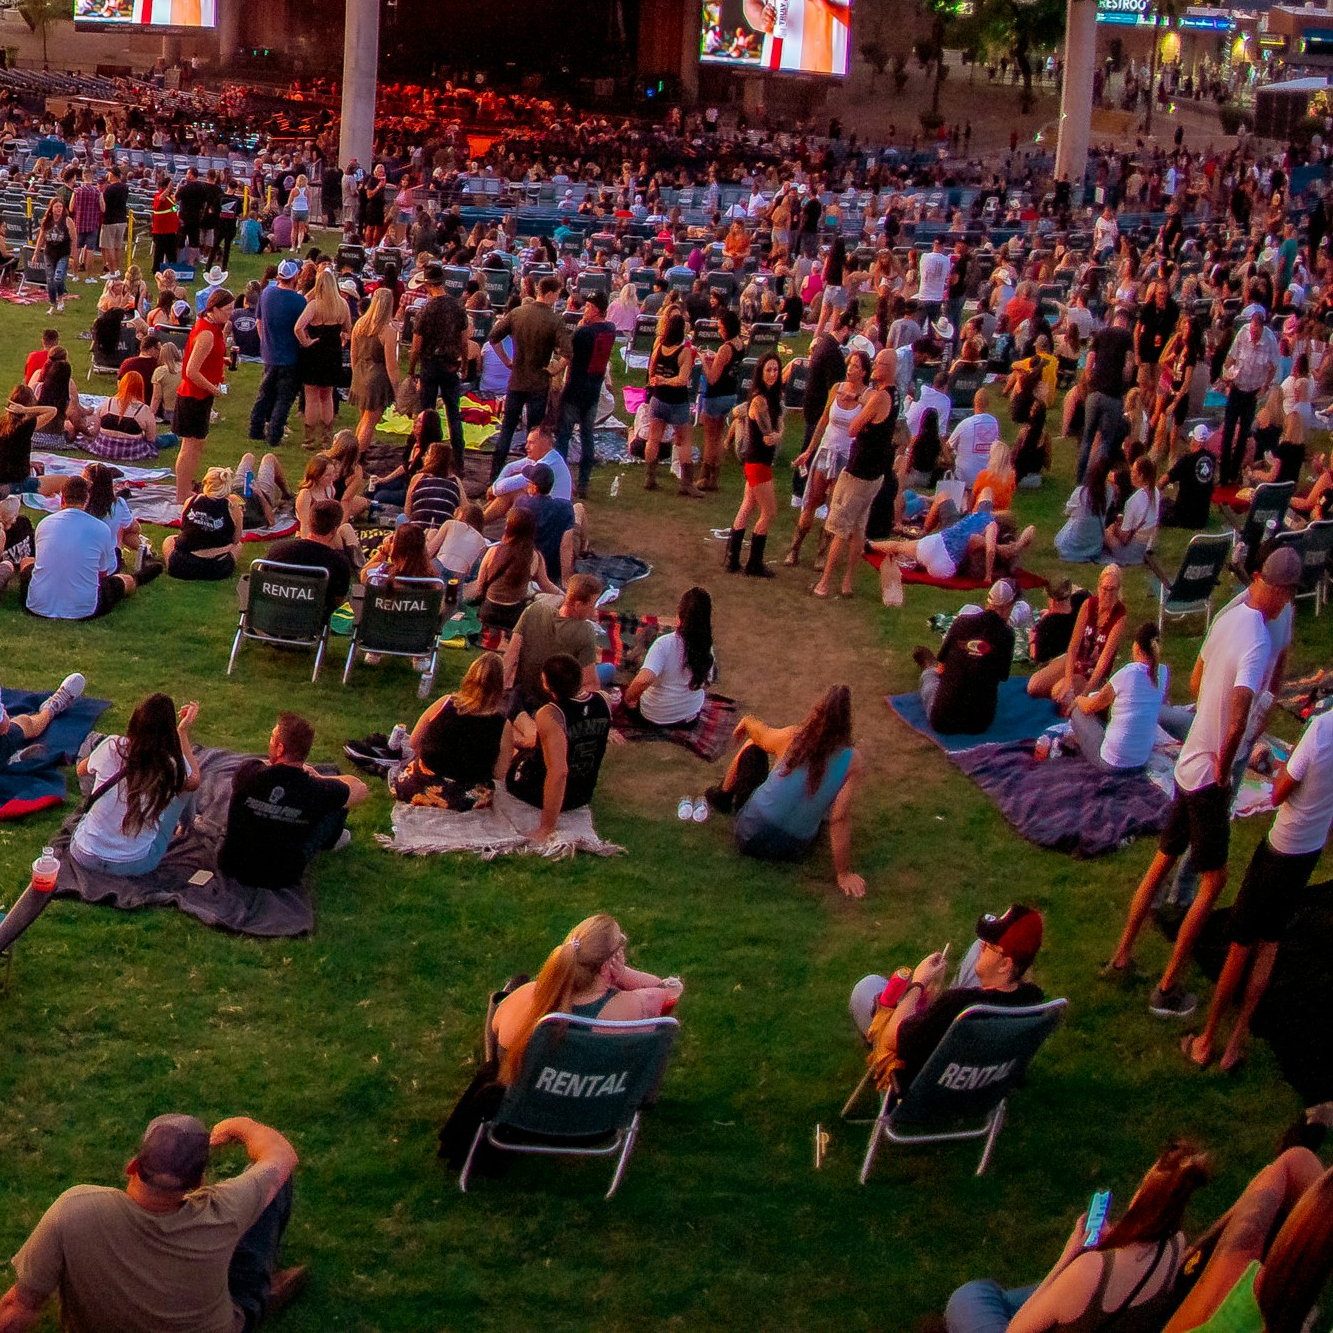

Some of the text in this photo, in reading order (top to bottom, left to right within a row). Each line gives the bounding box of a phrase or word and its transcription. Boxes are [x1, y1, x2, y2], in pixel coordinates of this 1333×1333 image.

[262, 582, 315, 600] RENTAL
[375, 597, 428, 612] RENTAL
[535, 1066, 627, 1098] RENTAL
